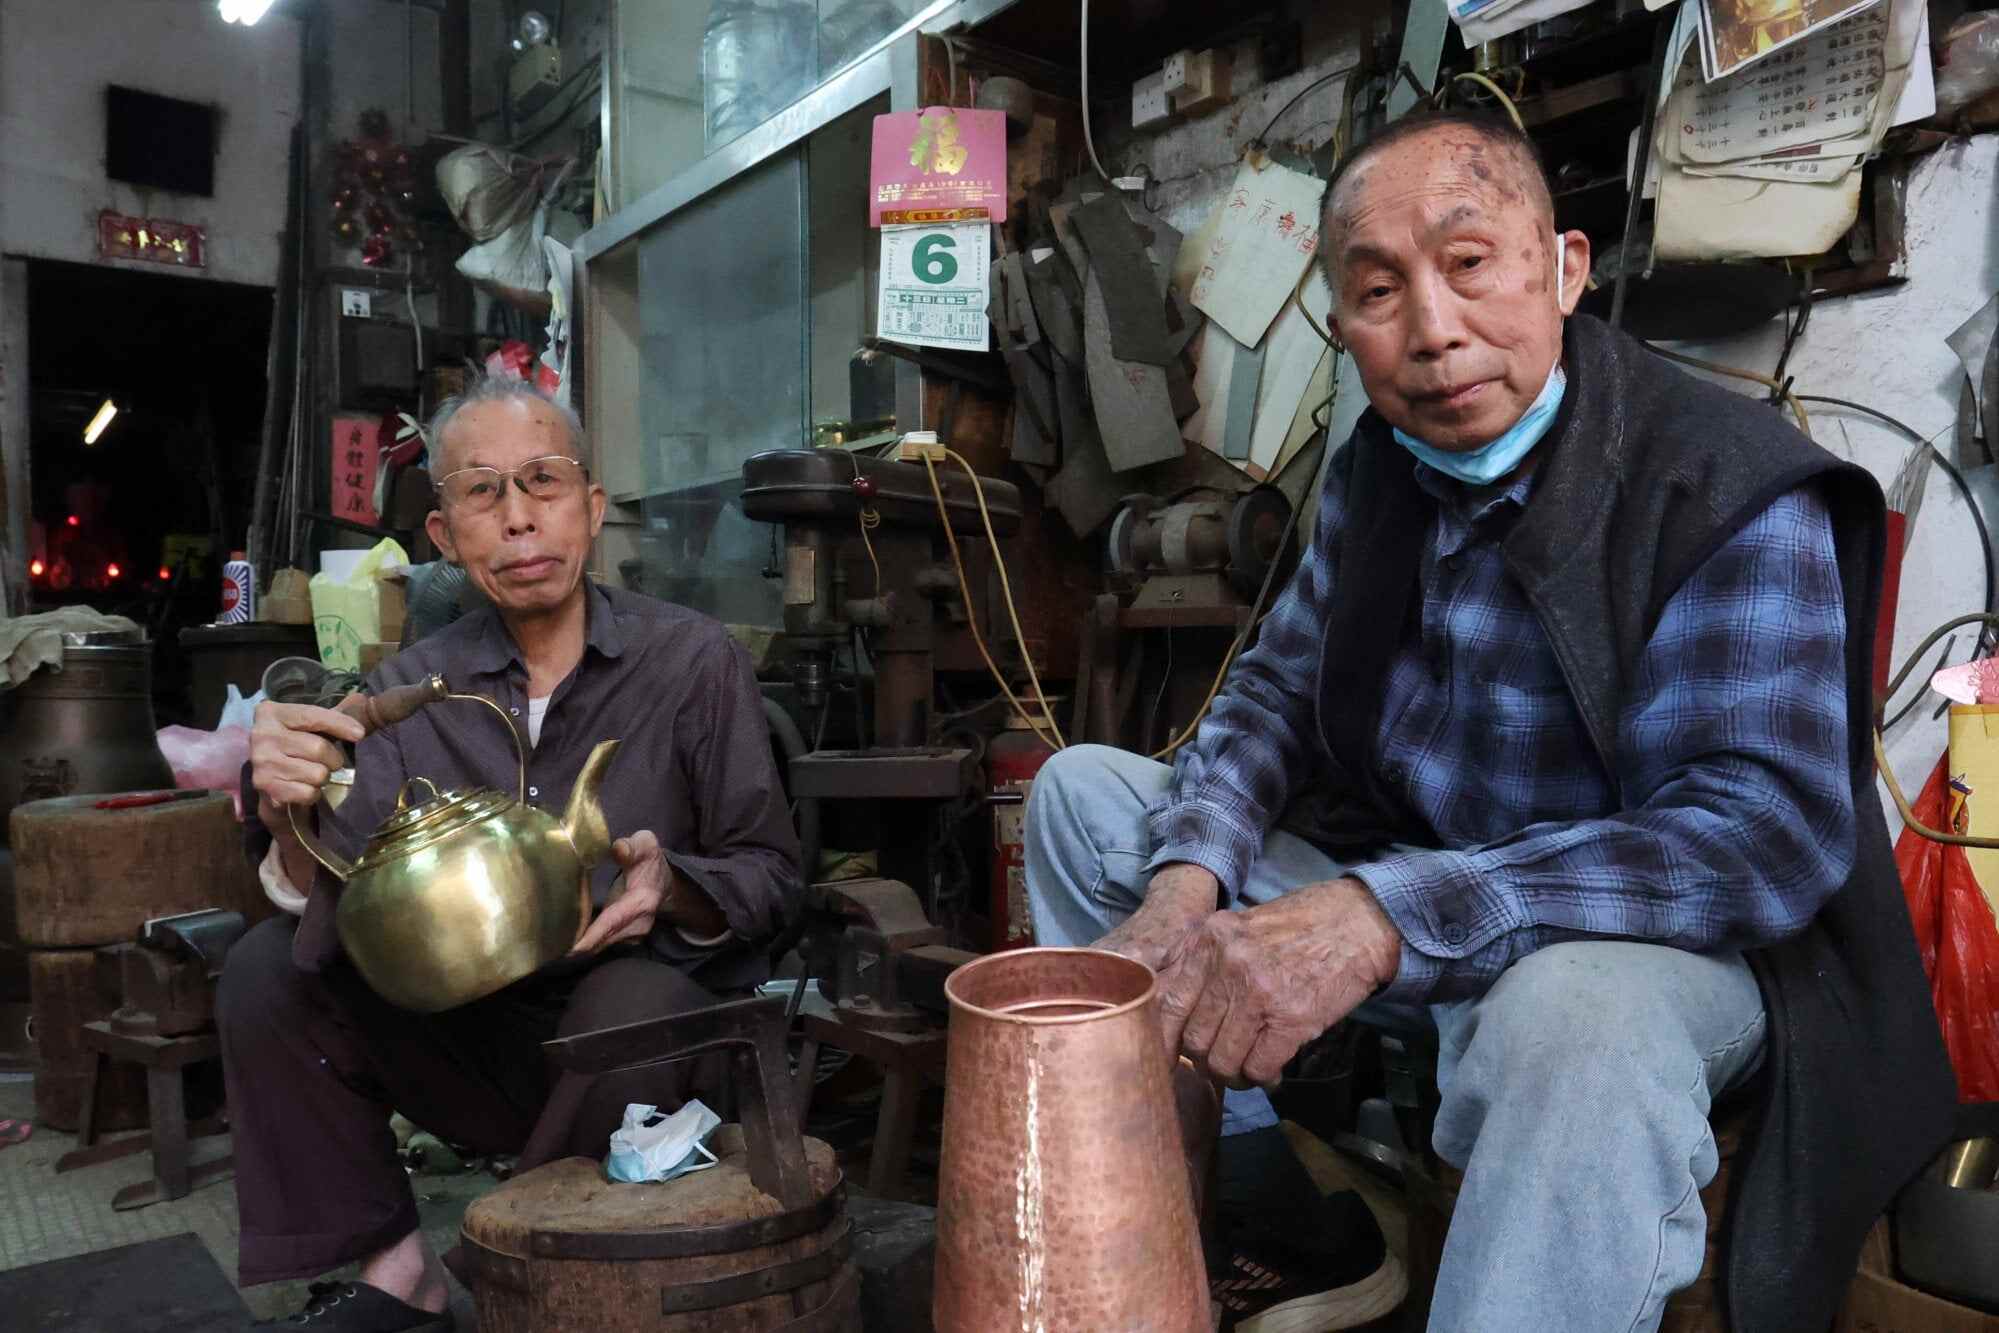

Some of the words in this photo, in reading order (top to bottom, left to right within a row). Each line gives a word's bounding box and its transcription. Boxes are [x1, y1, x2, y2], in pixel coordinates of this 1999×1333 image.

[909, 113, 968, 176] 福
[911, 233, 959, 285] 6
[345, 425, 366, 513] 身體健康
